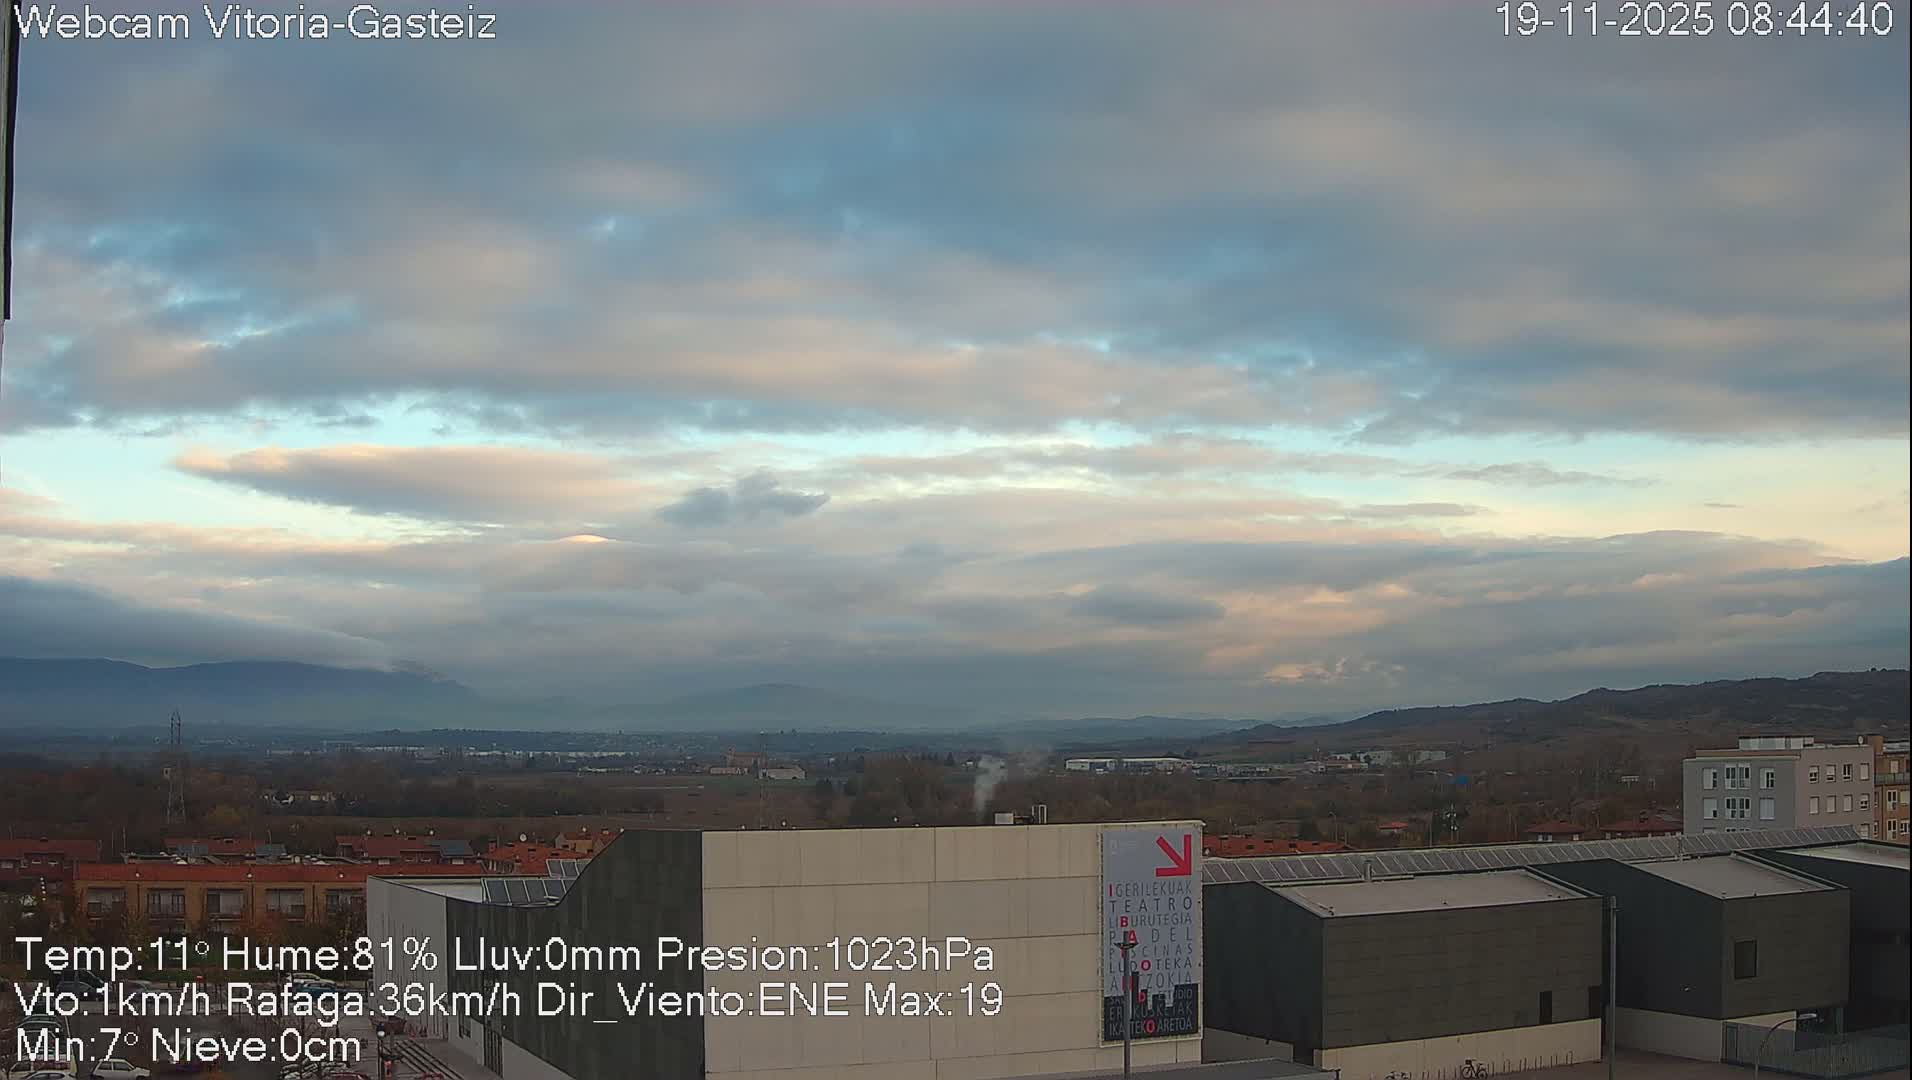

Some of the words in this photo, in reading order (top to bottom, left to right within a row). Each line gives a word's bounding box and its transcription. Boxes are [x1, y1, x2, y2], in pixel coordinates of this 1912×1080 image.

[1108, 880, 1192, 898] IGERILEKUAK
[1108, 896, 1193, 913] TEATRO
[1108, 911, 1193, 929] LIBURUTEGIA
[1109, 958, 1193, 974] LUDOTEKA
[1110, 972, 1193, 991] ANZOKIA
[1109, 1001, 1193, 1020] ERKUSKETAK
[1109, 1020, 1155, 1036] IKATEKO
[1157, 1016, 1193, 1033] ARETOA
